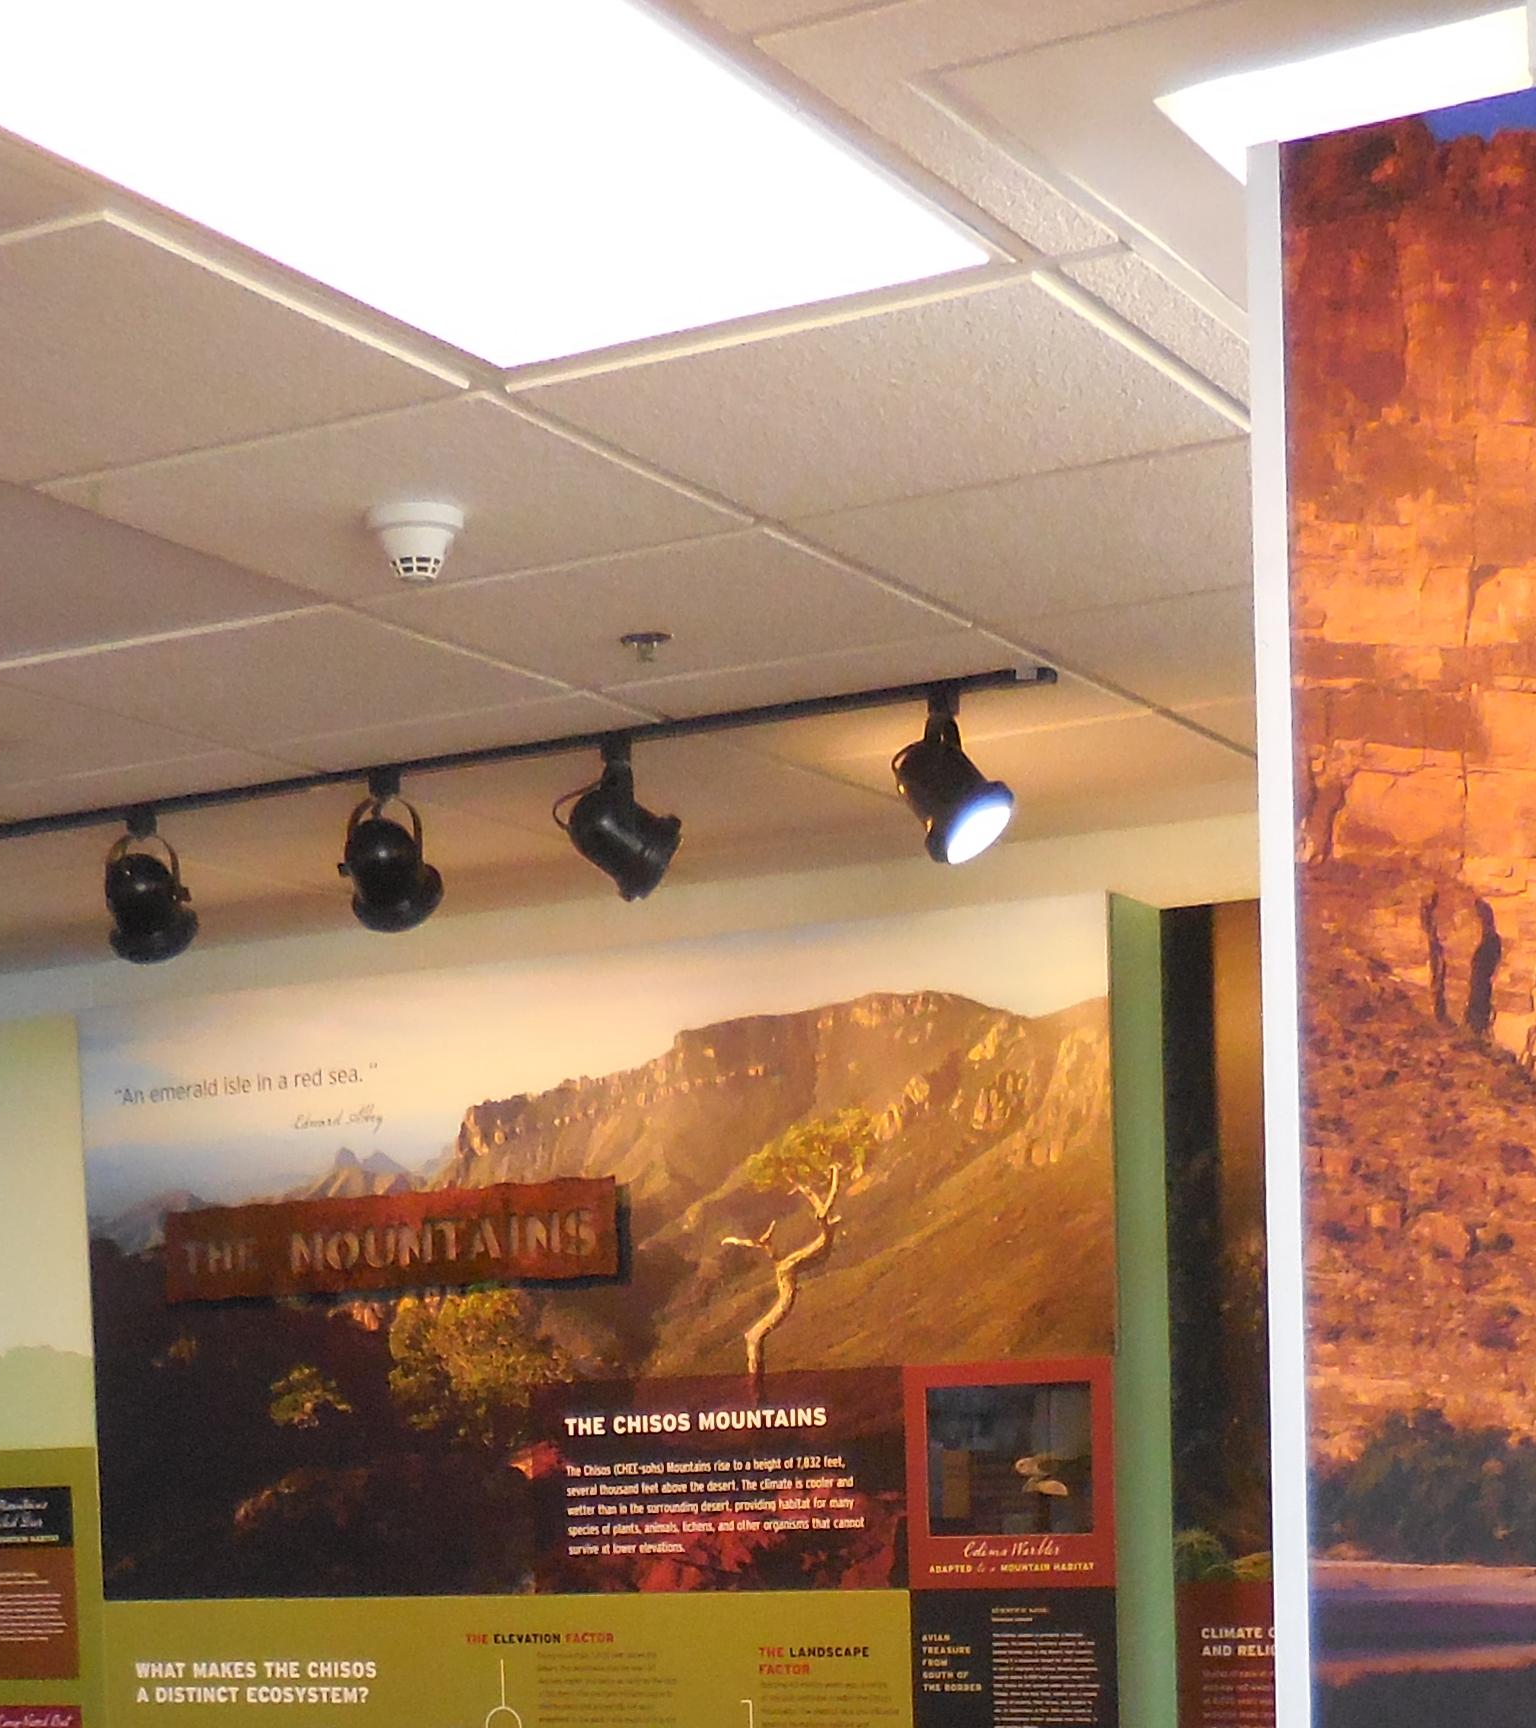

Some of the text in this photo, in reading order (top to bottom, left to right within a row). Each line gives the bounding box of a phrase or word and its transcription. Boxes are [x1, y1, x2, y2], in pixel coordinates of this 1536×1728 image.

[150, 1078, 218, 1103] emerald
[224, 1076, 251, 1095] isle
[257, 1073, 272, 1091] in
[278, 1076, 288, 1089] a
[294, 1068, 322, 1088] red
[290, 1209, 596, 1274] MOUNTAINS
[564, 1407, 827, 1436] THE CHISOS MOUNTAINS
[566, 1458, 793, 1476] The Chisos Mountains to of
[567, 1476, 854, 1496] several thousand above the The climate is cooler and
[630, 1503, 644, 1514] the
[734, 1499, 776, 1513] providing
[779, 1498, 810, 1510] habitat
[813, 1497, 826, 1508] for
[929, 1565, 972, 1574] ADAPTED
[1000, 1563, 1050, 1573] MOUNTAIN
[493, 1633, 561, 1644] ELEVATION
[566, 1633, 614, 1644] FACTOR
[1201, 1627, 1263, 1639] CLIMATE
[759, 1646, 870, 1657] THE LANDSCAPE
[1202, 1645, 1232, 1657] AND
[135, 1662, 376, 1678] WHAT MAKES THE CHISOS
[759, 1664, 810, 1675] FACTOR
[136, 1687, 369, 1703] A DISTINCT ECOSYSTEM?
